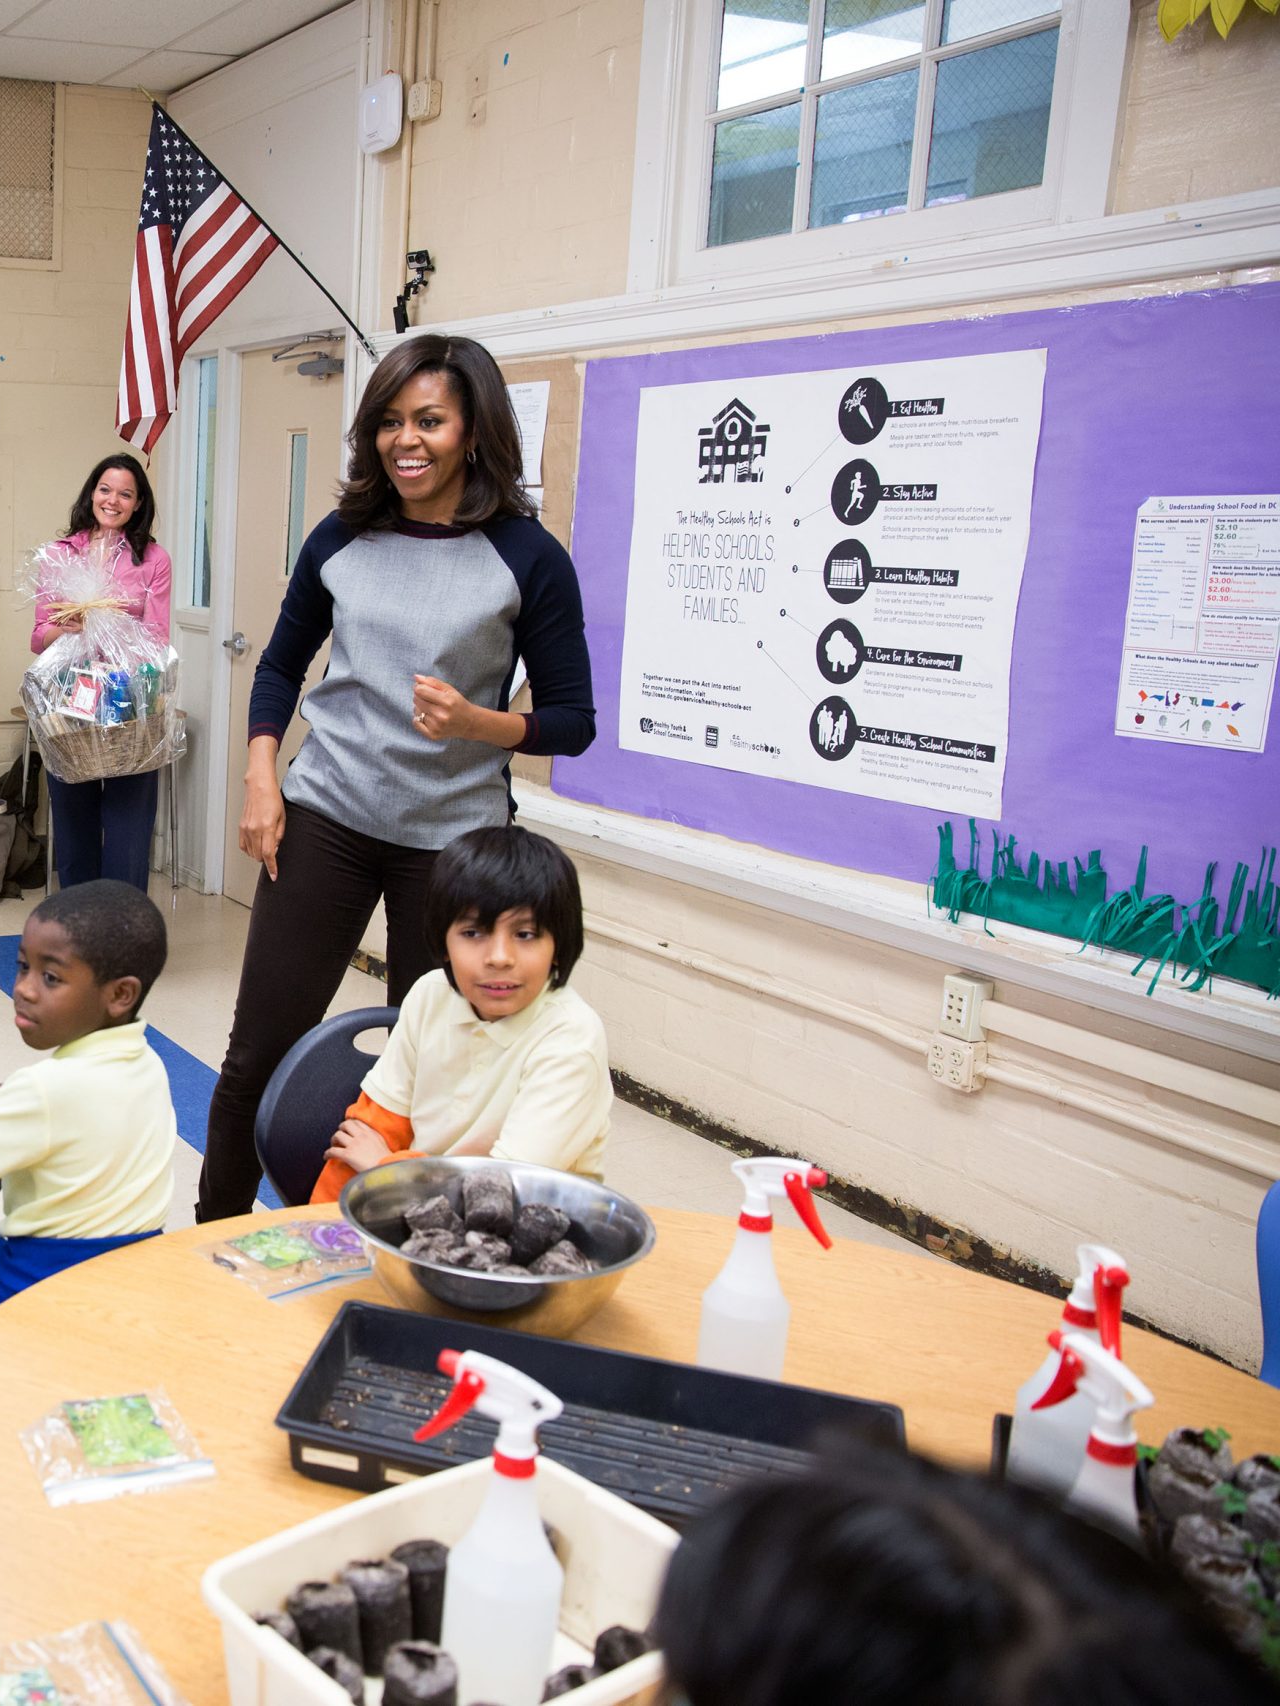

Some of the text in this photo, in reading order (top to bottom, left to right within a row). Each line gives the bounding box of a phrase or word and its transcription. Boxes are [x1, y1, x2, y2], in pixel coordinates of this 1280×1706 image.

[900, 401, 912, 415] Eat
[913, 400, 938, 415] Healthy
[882, 486, 934, 500] 2. Stay Active
[676, 510, 771, 528] The Healthy Schools Act is
[663, 533, 775, 562] HELPING SCHOOLS,
[668, 564, 765, 593] STUDENTS AND
[875, 569, 954, 585] 3. Learn Healthy Habits
[867, 649, 874, 659] 4.
[876, 649, 890, 661] Care
[904, 651, 914, 665] the
[917, 653, 955, 669] Environment
[865, 668, 885, 676] Gardens
[895, 672, 924, 681] blossoming
[952, 678, 971, 686] District
[973, 681, 993, 689] schools
[664, 687, 694, 696] information,
[654, 721, 669, 729] Healthy
[671, 724, 682, 732] Youth
[668, 731, 693, 741] Commission
[860, 728, 986, 760] 5. Create Healthy School Communities
[860, 768, 878, 776] Schools
[888, 772, 910, 782] adopting
[911, 777, 929, 786] healthy
[930, 780, 950, 790] vending
[963, 786, 992, 797] fundraising
